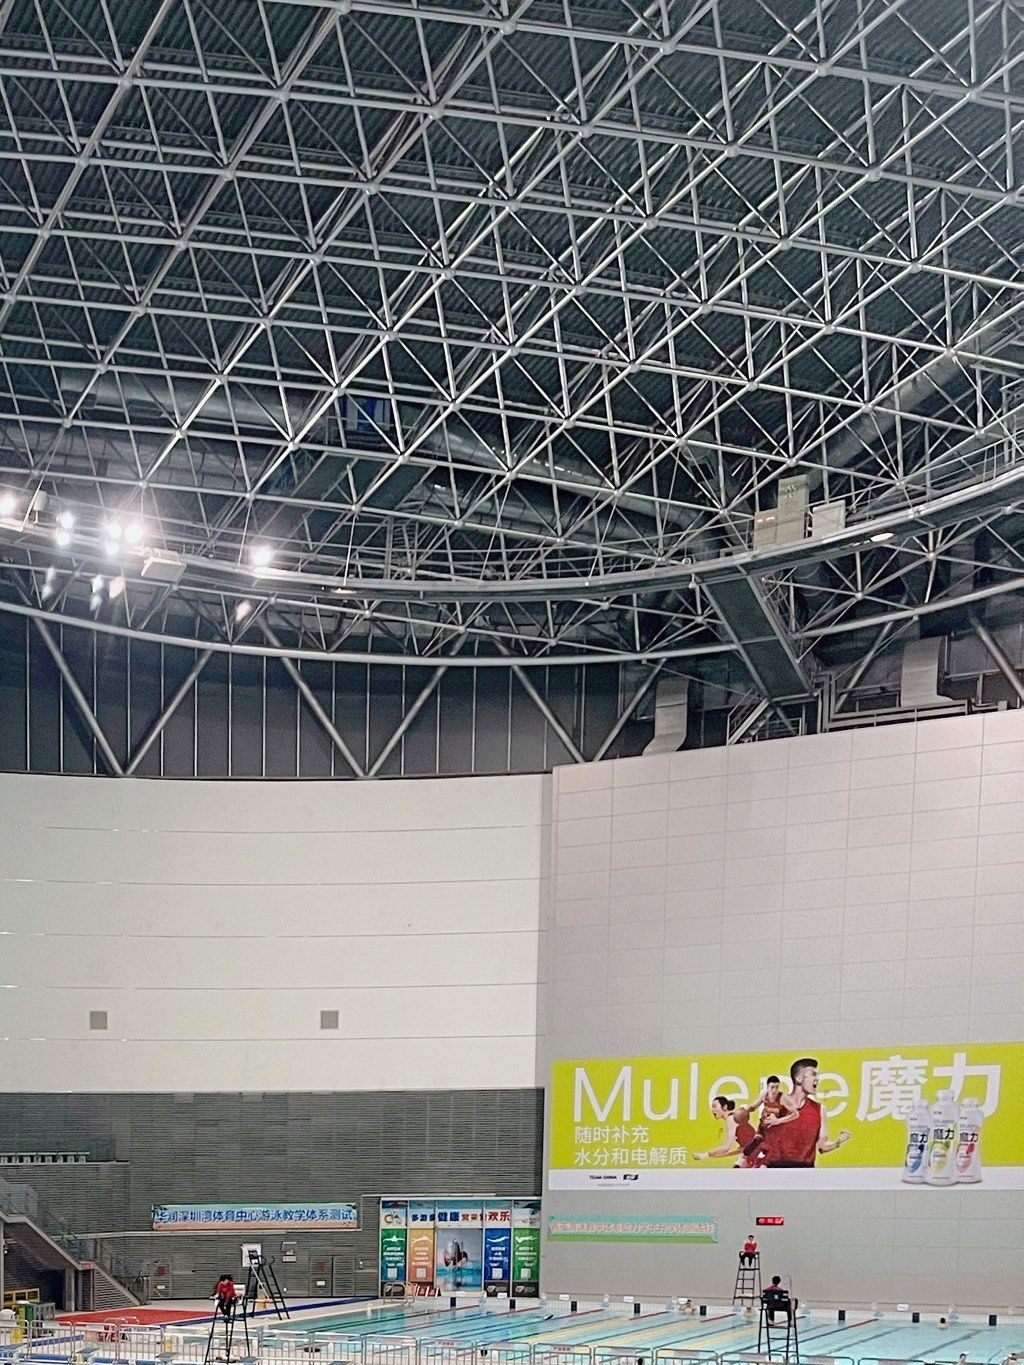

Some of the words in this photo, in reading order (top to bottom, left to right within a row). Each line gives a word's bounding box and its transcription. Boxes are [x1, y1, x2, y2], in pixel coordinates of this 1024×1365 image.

[855, 1052, 1002, 1121] 魔力
[575, 1125, 650, 1144] 随时补充
[575, 1147, 687, 1166] 水分和电解质
